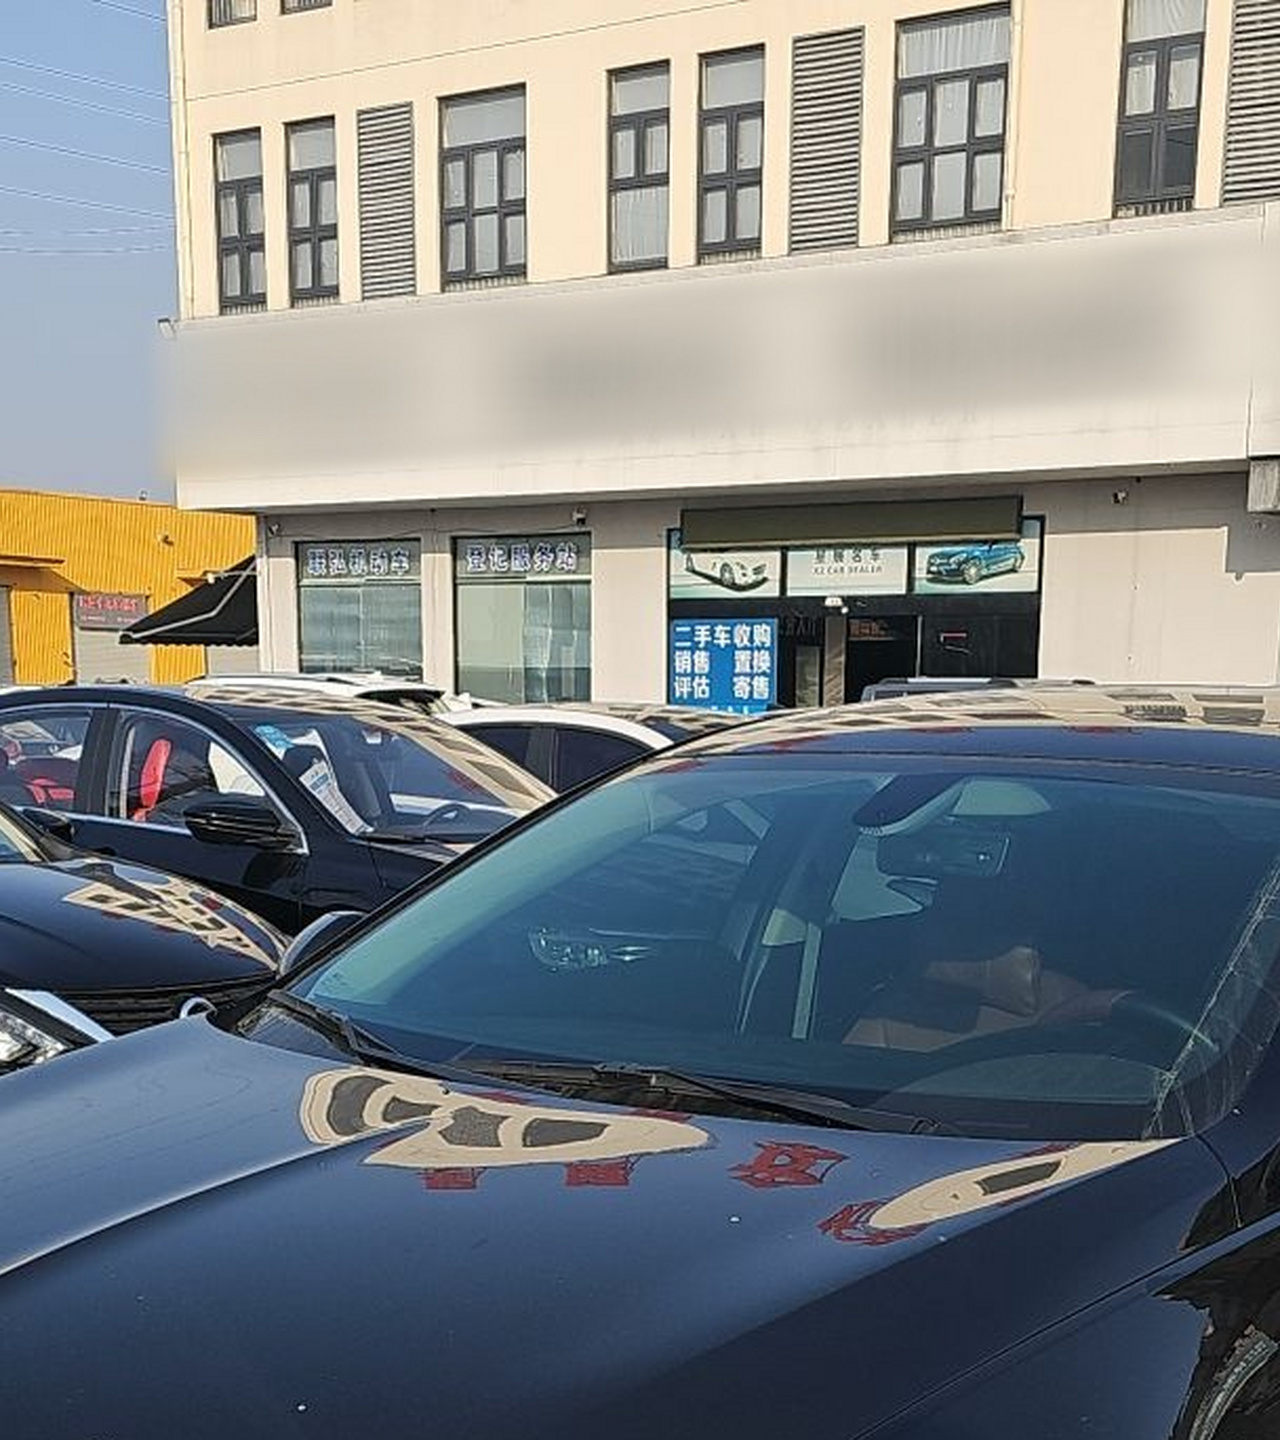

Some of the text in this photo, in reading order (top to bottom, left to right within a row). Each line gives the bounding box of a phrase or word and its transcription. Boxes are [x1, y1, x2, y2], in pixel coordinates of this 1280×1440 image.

[466, 542, 578, 573] 登记服务站
[675, 623, 771, 649] 二手车收购
[674, 650, 771, 675] 销售 置换
[674, 675, 770, 700] 评估 寄售
